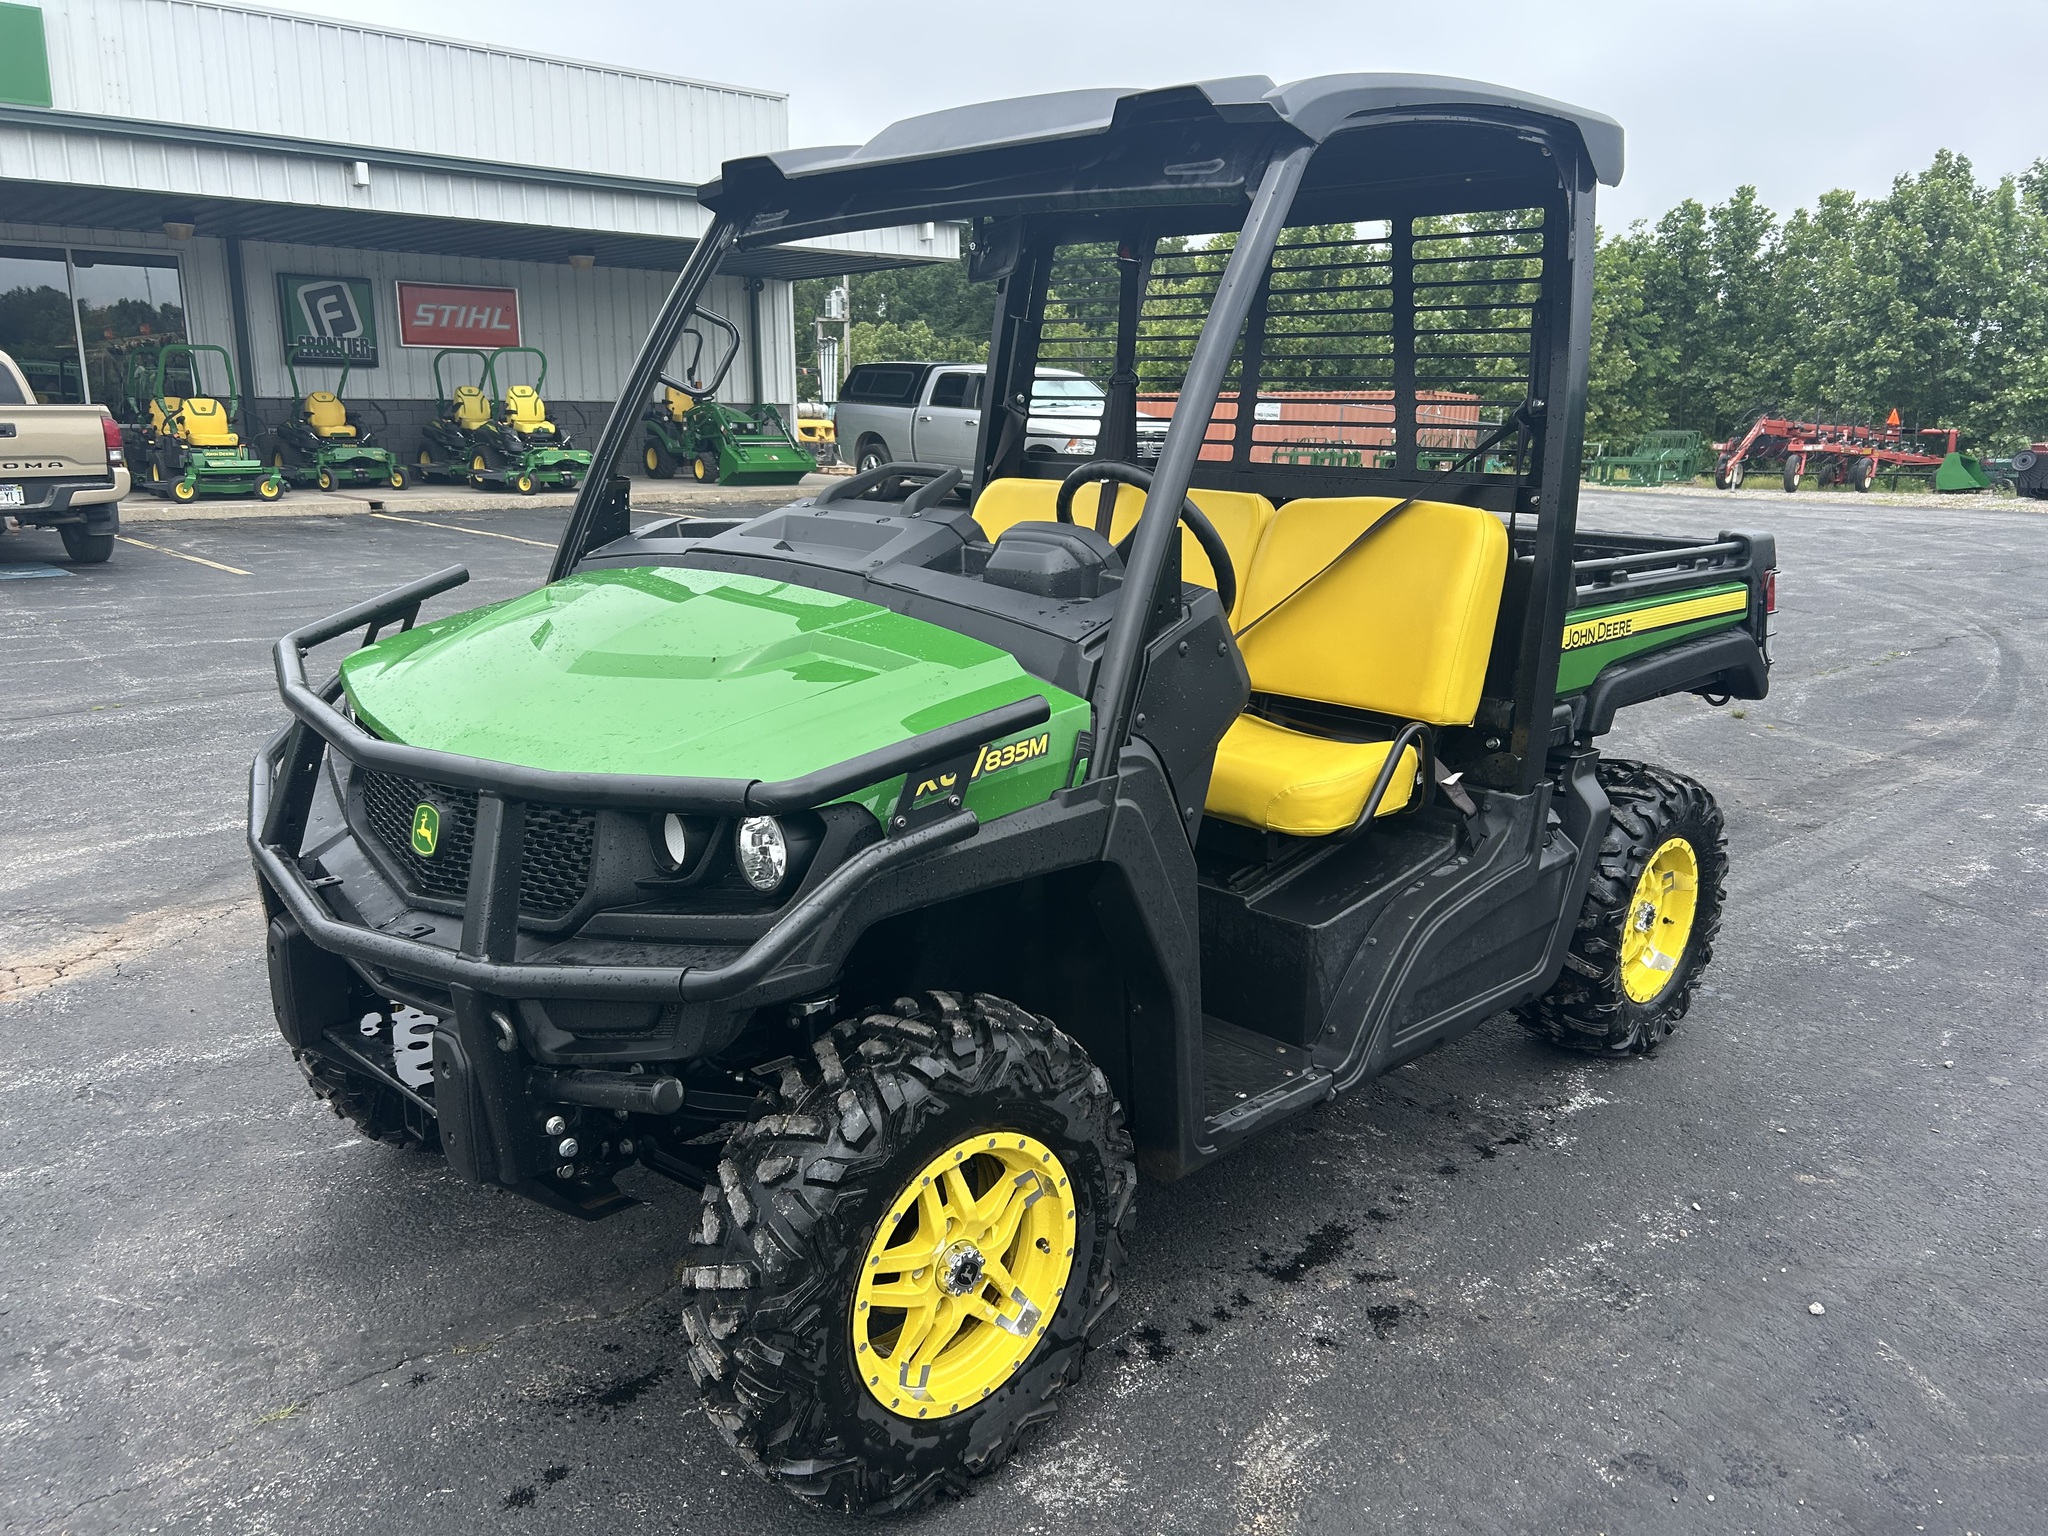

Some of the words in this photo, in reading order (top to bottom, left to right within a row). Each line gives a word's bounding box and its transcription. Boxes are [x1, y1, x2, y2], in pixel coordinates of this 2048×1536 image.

[412, 304, 510, 330] STIHL
[298, 336, 371, 356] FRONTIER
[1565, 627, 1596, 647] JOHN
[1598, 619, 1633, 640] DEERE
